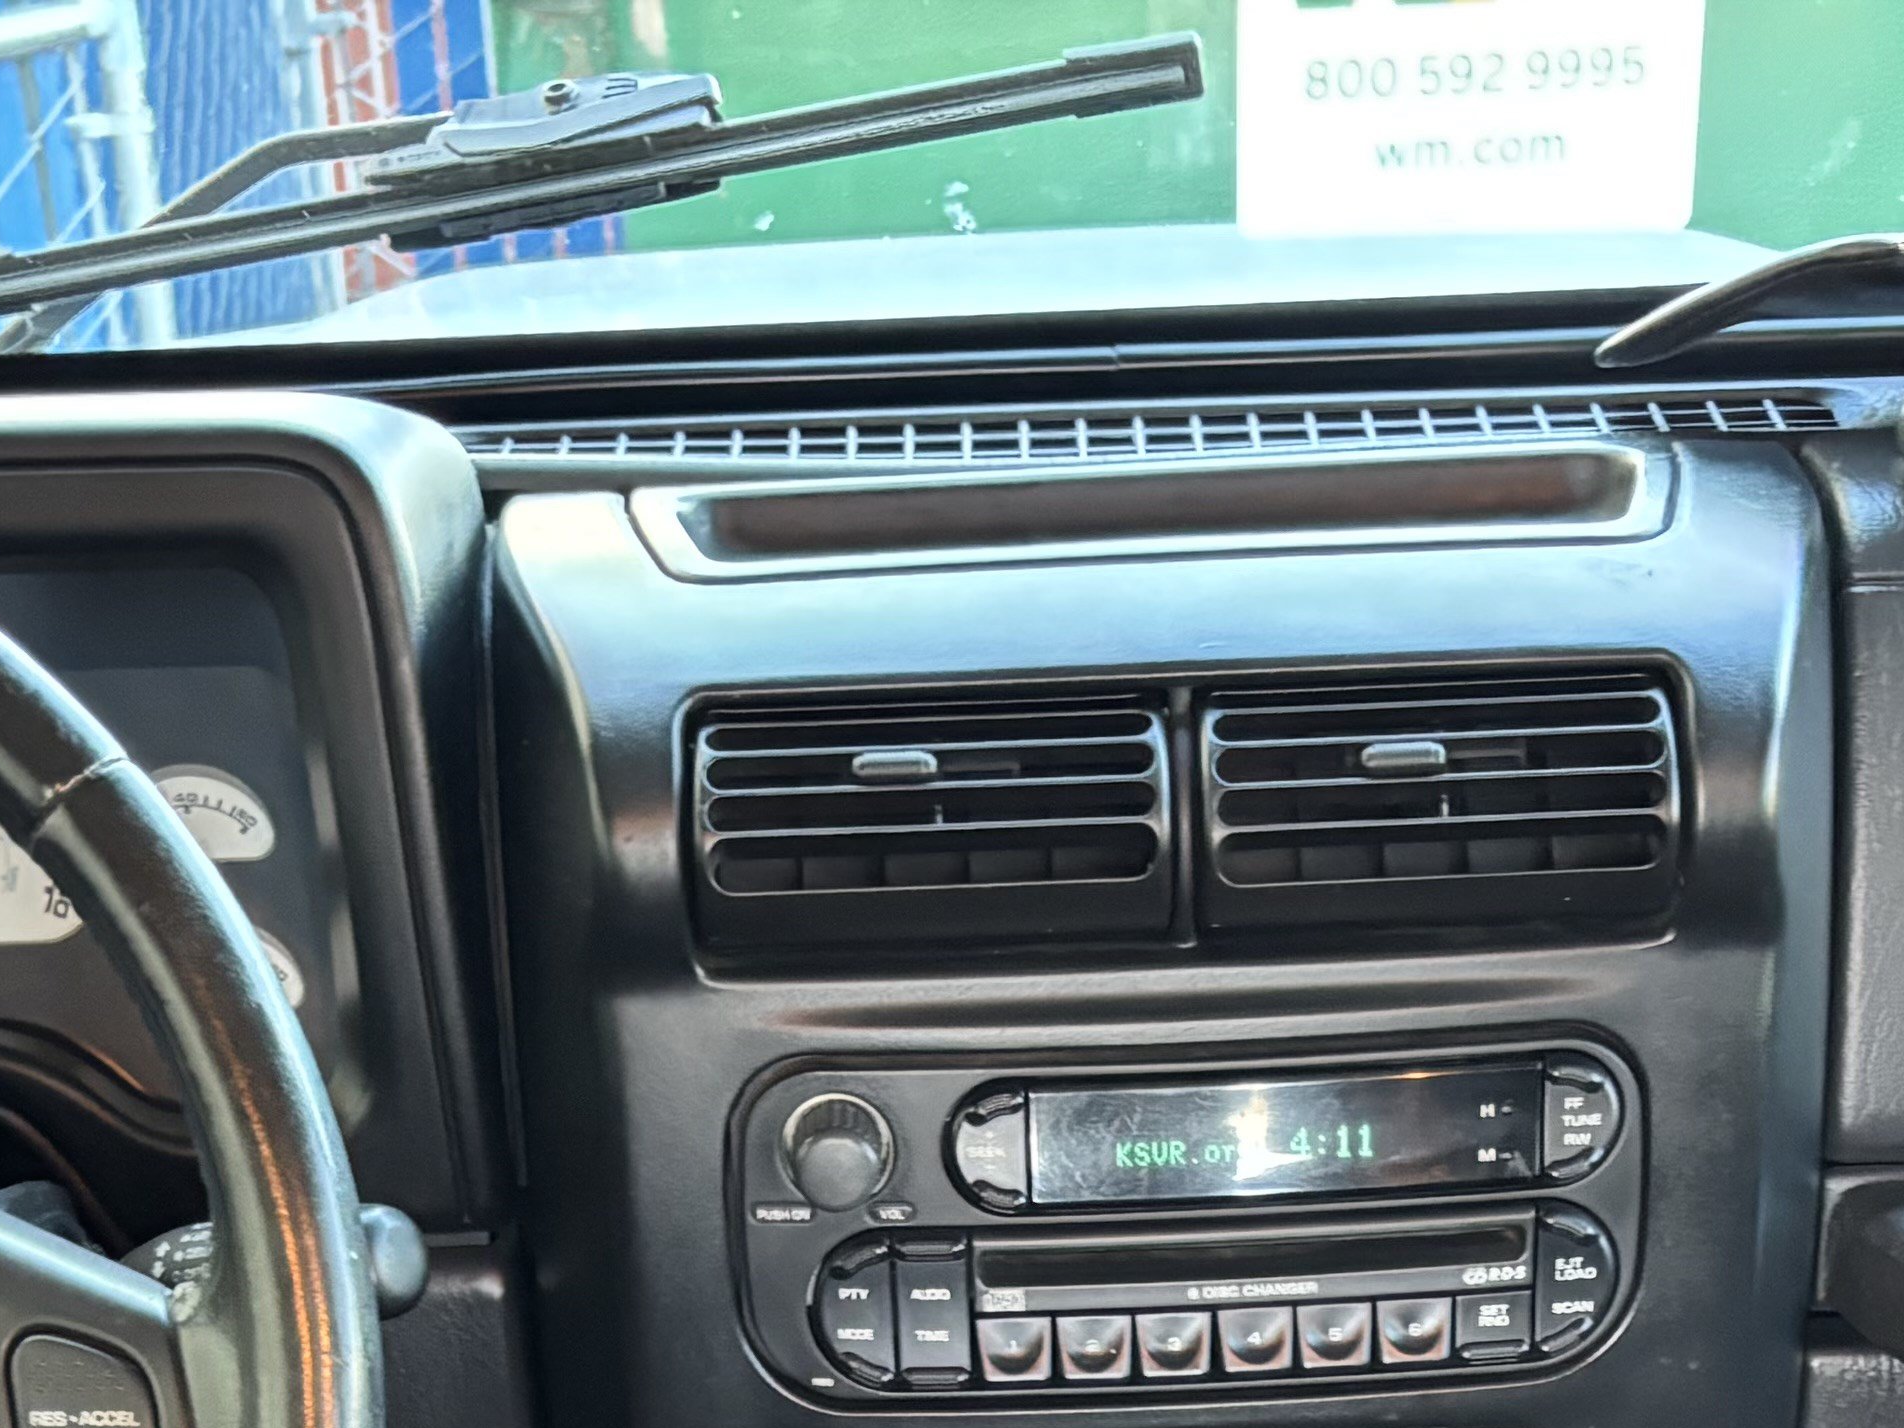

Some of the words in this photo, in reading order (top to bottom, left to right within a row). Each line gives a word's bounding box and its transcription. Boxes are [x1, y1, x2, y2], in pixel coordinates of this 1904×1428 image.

[1305, 57, 1397, 100] 800
[1419, 52, 1504, 96] 592
[1526, 45, 1646, 90] 9995
[1374, 133, 1566, 168] wm.com
[1479, 1103, 1496, 1119] H
[1560, 1112, 1603, 1128] TUNE
[1115, 1140, 1238, 1168] KSUR.or
[1290, 1123, 1375, 1158] 4:11
[1477, 1148, 1497, 1163] M
[1554, 1266, 1598, 1282] LOAD
[1201, 1285, 1241, 1300] DISC
[1242, 1281, 1319, 1298] CHANGER
[1551, 1300, 1596, 1315] SCAN
[1246, 1330, 1263, 1345] 4
[1327, 1327, 1344, 1342] 5
[1408, 1322, 1424, 1338] 6
[1166, 1336, 1183, 1352] 3
